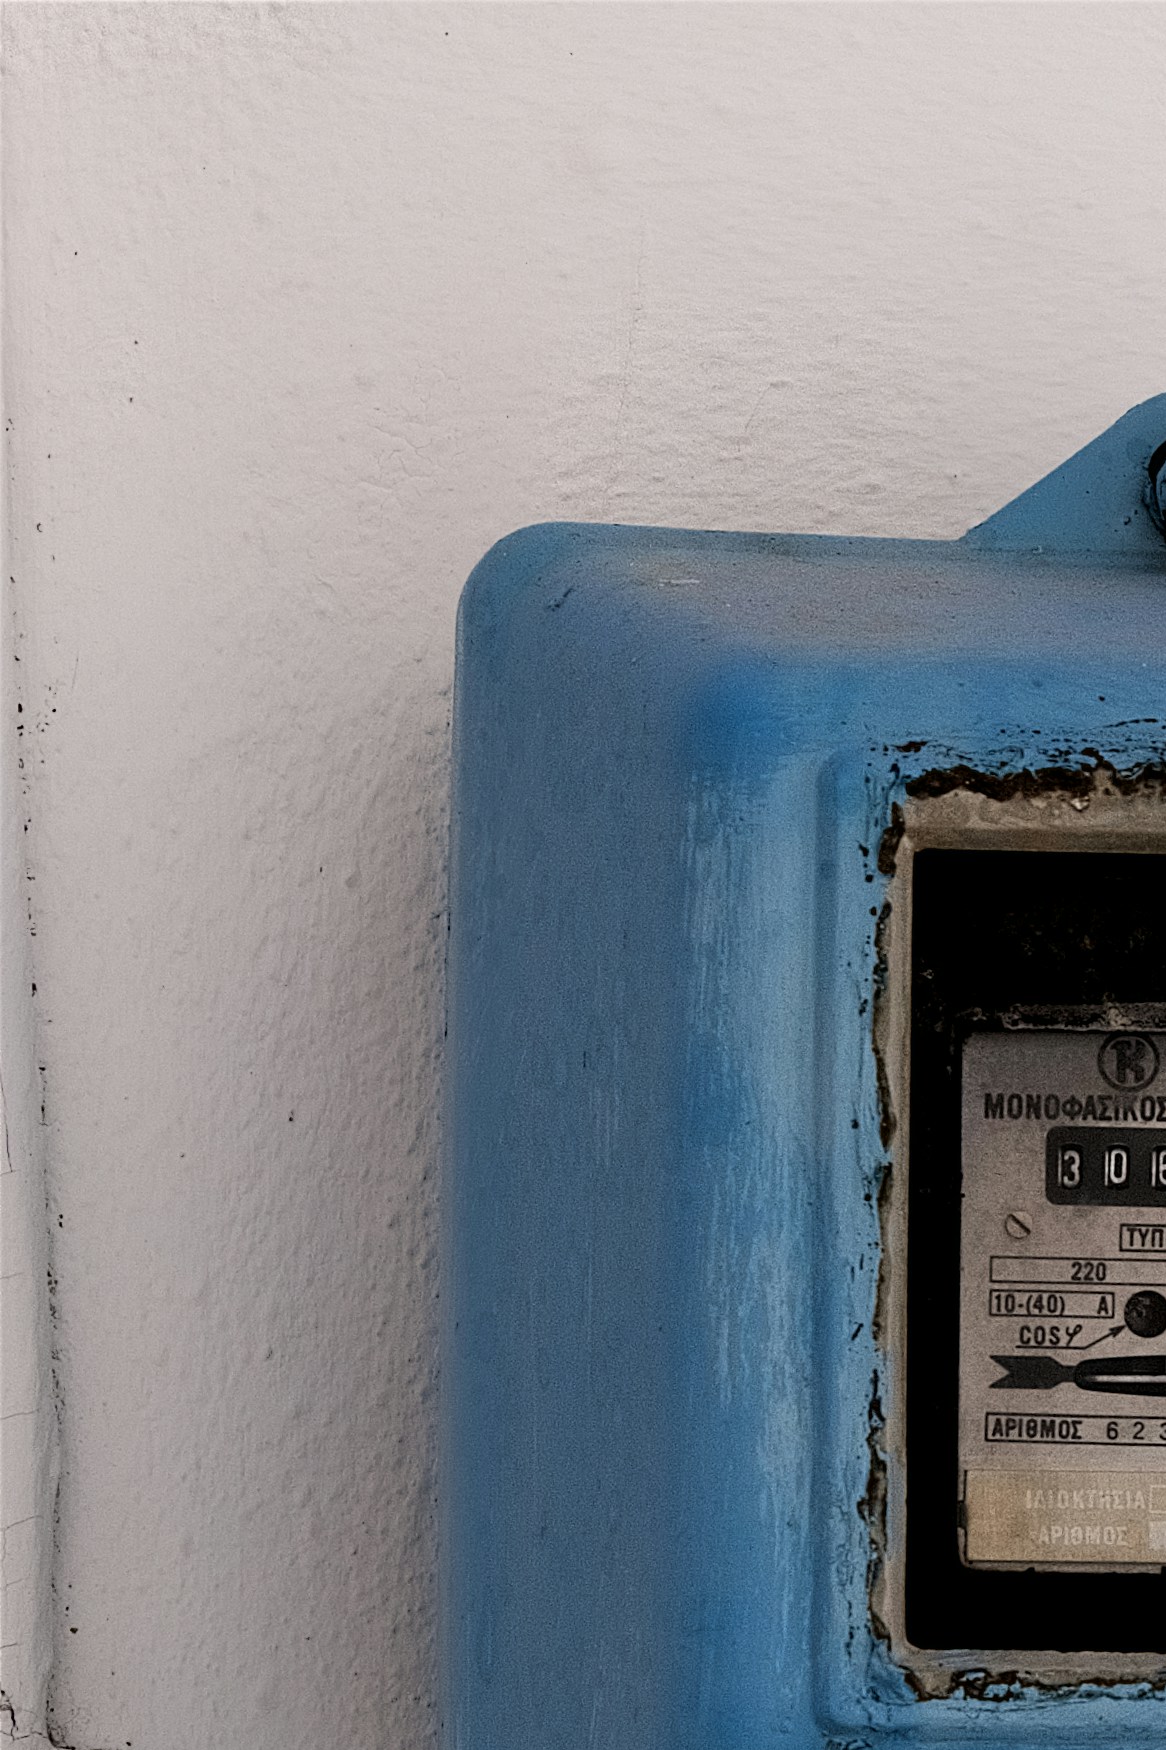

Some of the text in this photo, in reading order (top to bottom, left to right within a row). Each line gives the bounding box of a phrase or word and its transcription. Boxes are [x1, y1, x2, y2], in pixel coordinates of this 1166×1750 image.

[1070, 1261, 1107, 1282] 220
[1097, 1293, 1110, 1316] A
[991, 1418, 1083, 1441] ΑΡΙΘΜΟΣ
